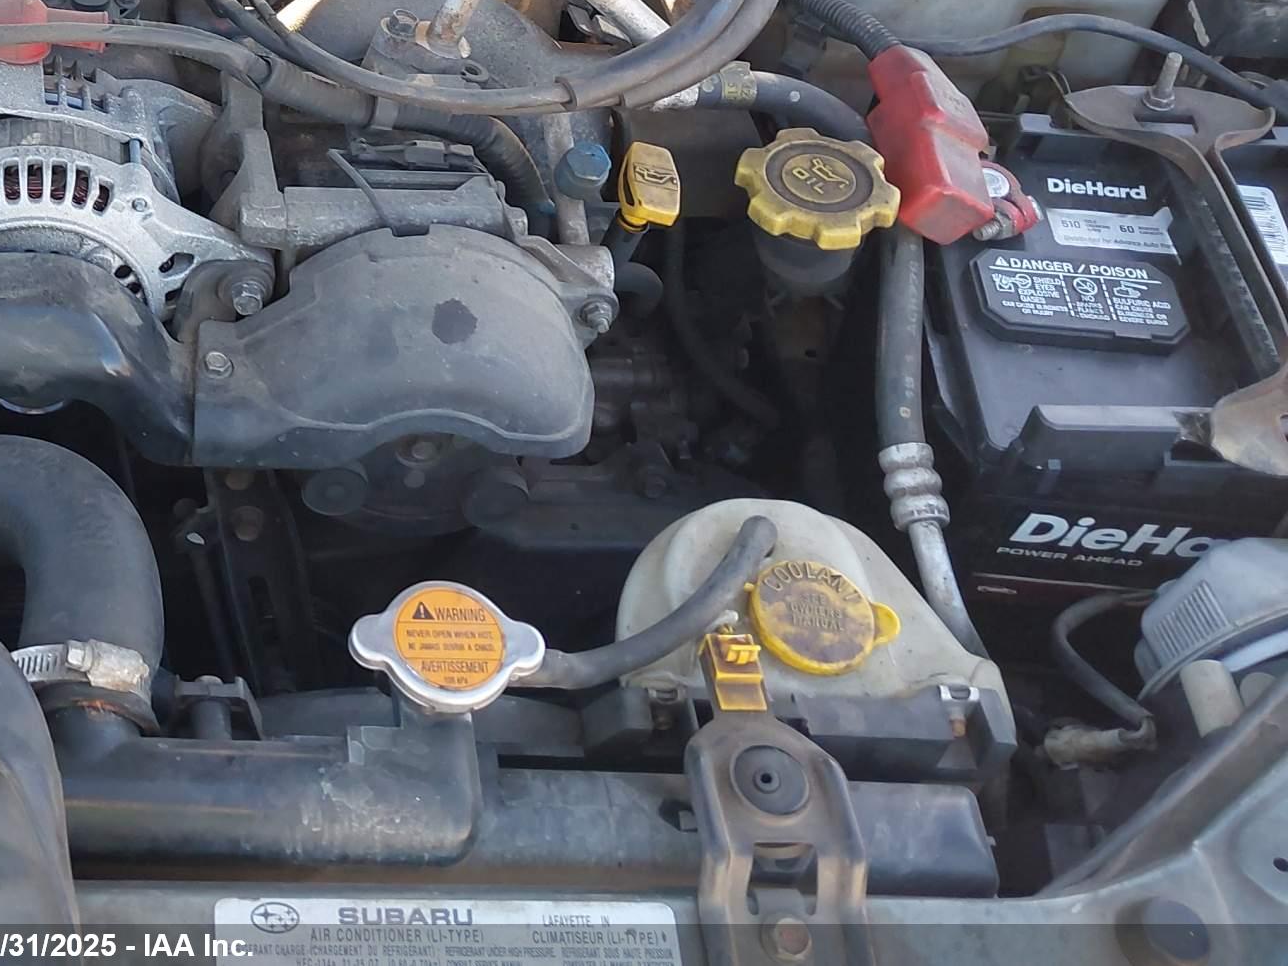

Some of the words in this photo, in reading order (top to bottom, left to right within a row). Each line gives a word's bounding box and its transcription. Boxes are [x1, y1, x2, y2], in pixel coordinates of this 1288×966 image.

[792, 167, 824, 194] OIL
[1046, 177, 1147, 200] DieHard
[1061, 219, 1081, 229] 510
[1119, 224, 1135, 234] 60
[1010, 257, 1074, 273] DANGER
[1090, 264, 1148, 280] POISON
[1032, 276, 1061, 286] SHIELD
[1034, 283, 1056, 291] EYES
[1018, 288, 1061, 299] EXPLOSIVE
[1081, 294, 1095, 302] NO
[1112, 296, 1151, 308] SULFURIC
[1009, 512, 1214, 559] DieHa
[996, 545, 1067, 560] POWER
[1072, 554, 1144, 567] AHEAD
[763, 561, 862, 602] COOLANT
[434, 607, 486, 622] WARNING
[406, 629, 430, 638] NEVER
[431, 630, 452, 638] OPEN
[454, 631, 476, 639] WHEN
[421, 660, 488, 674] AVERTISSEMENT
[337, 906, 473, 926] SUBARU
[600, 915, 611, 928] IN
[310, 927, 331, 942] AIR
[336, 927, 422, 943] CONDITIONER
[426, 928, 484, 944] (LI-TYPE)
[532, 929, 605, 945] CLIMATISEUR
[606, 928, 659, 946] (LI-TYPE)
